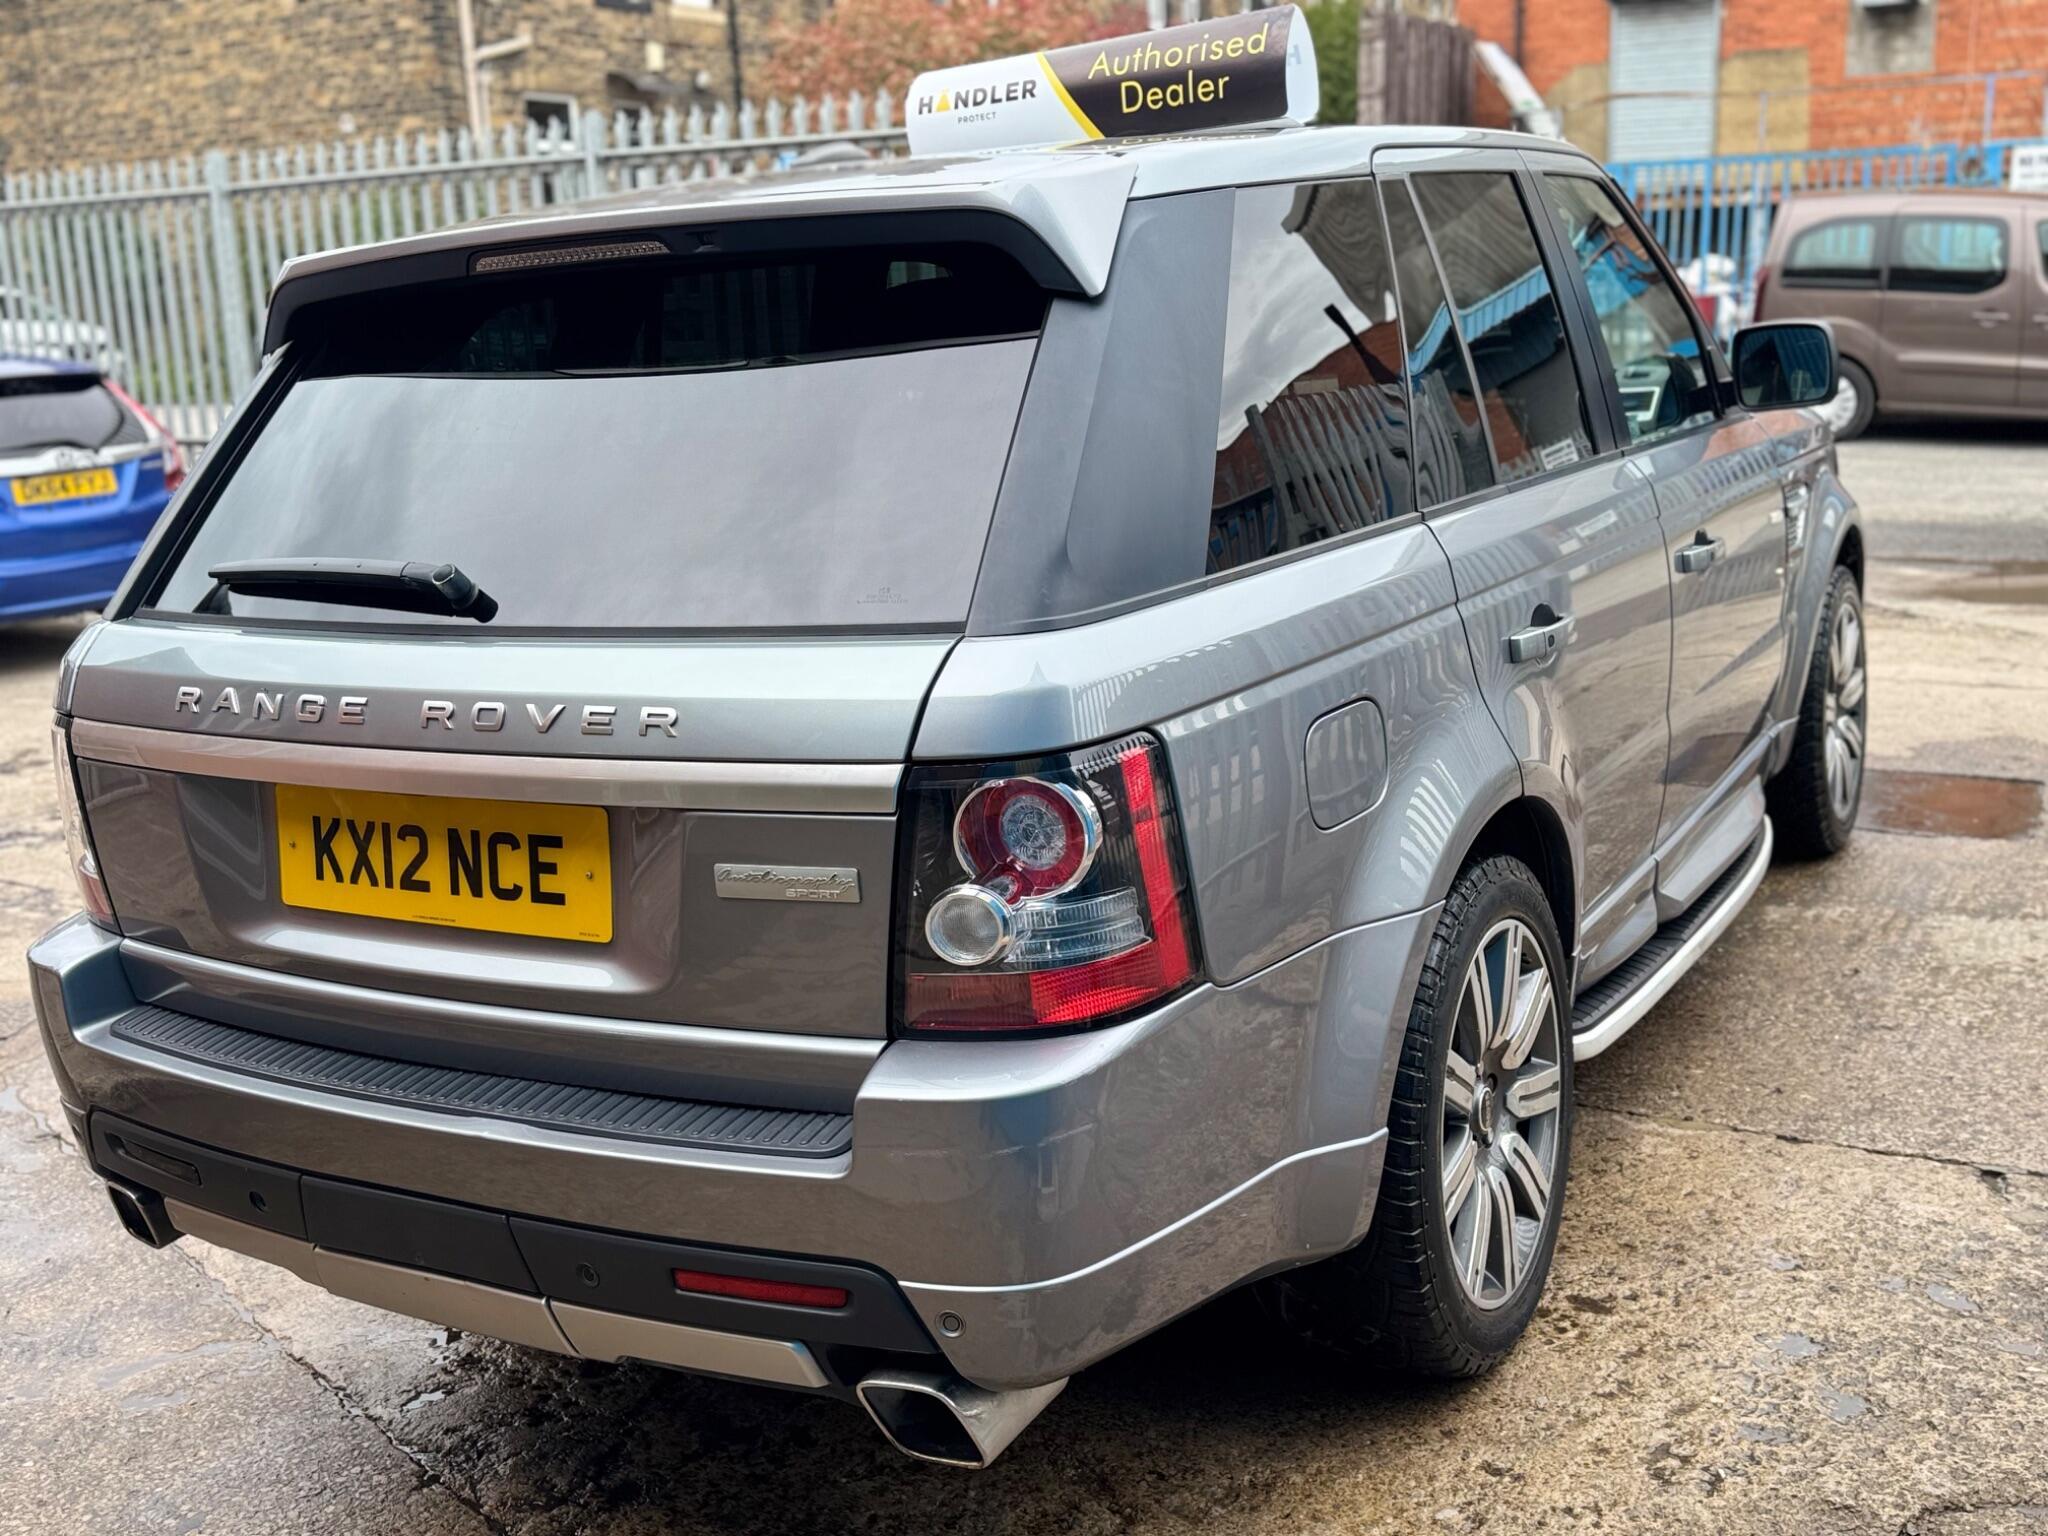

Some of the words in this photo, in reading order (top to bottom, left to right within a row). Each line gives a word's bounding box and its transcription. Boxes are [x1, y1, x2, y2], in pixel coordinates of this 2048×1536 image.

[1088, 22, 1269, 79] Authorised
[1120, 70, 1230, 114] Dealer
[958, 111, 997, 124] PROTECT
[175, 685, 369, 725] RANGE
[419, 699, 679, 738] ROVER
[312, 815, 431, 893] KX12
[448, 827, 566, 906] NCE
[785, 888, 840, 899] SPORT
